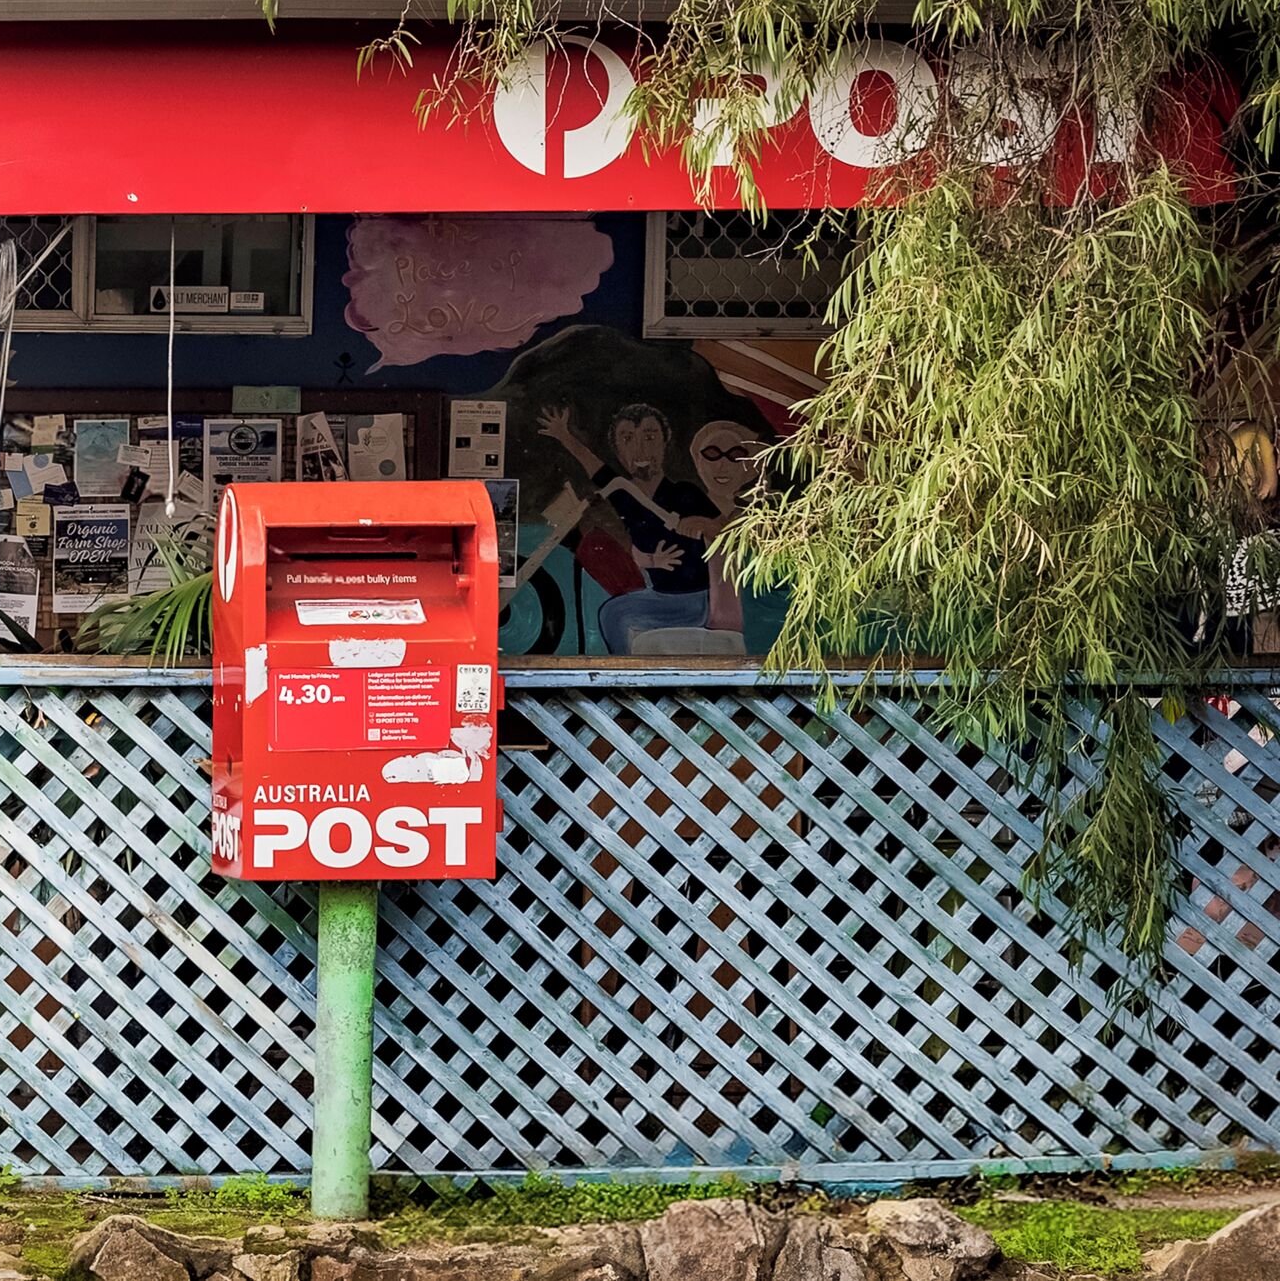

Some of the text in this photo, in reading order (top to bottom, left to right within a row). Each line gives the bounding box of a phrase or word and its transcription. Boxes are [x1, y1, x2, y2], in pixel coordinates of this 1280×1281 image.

[388, 292, 544, 335] Love
[67, 522, 118, 536] Organic
[57, 536, 93, 549] Farm
[93, 536, 127, 549] Shop
[69, 549, 112, 563] OPEN
[286, 574, 302, 584] Pull
[366, 574, 390, 585] bulky
[392, 573, 417, 584] items
[278, 684, 331, 705] 4.30
[253, 784, 371, 803] AUSTRALIA
[212, 811, 241, 862] POST
[253, 806, 482, 869] POST
